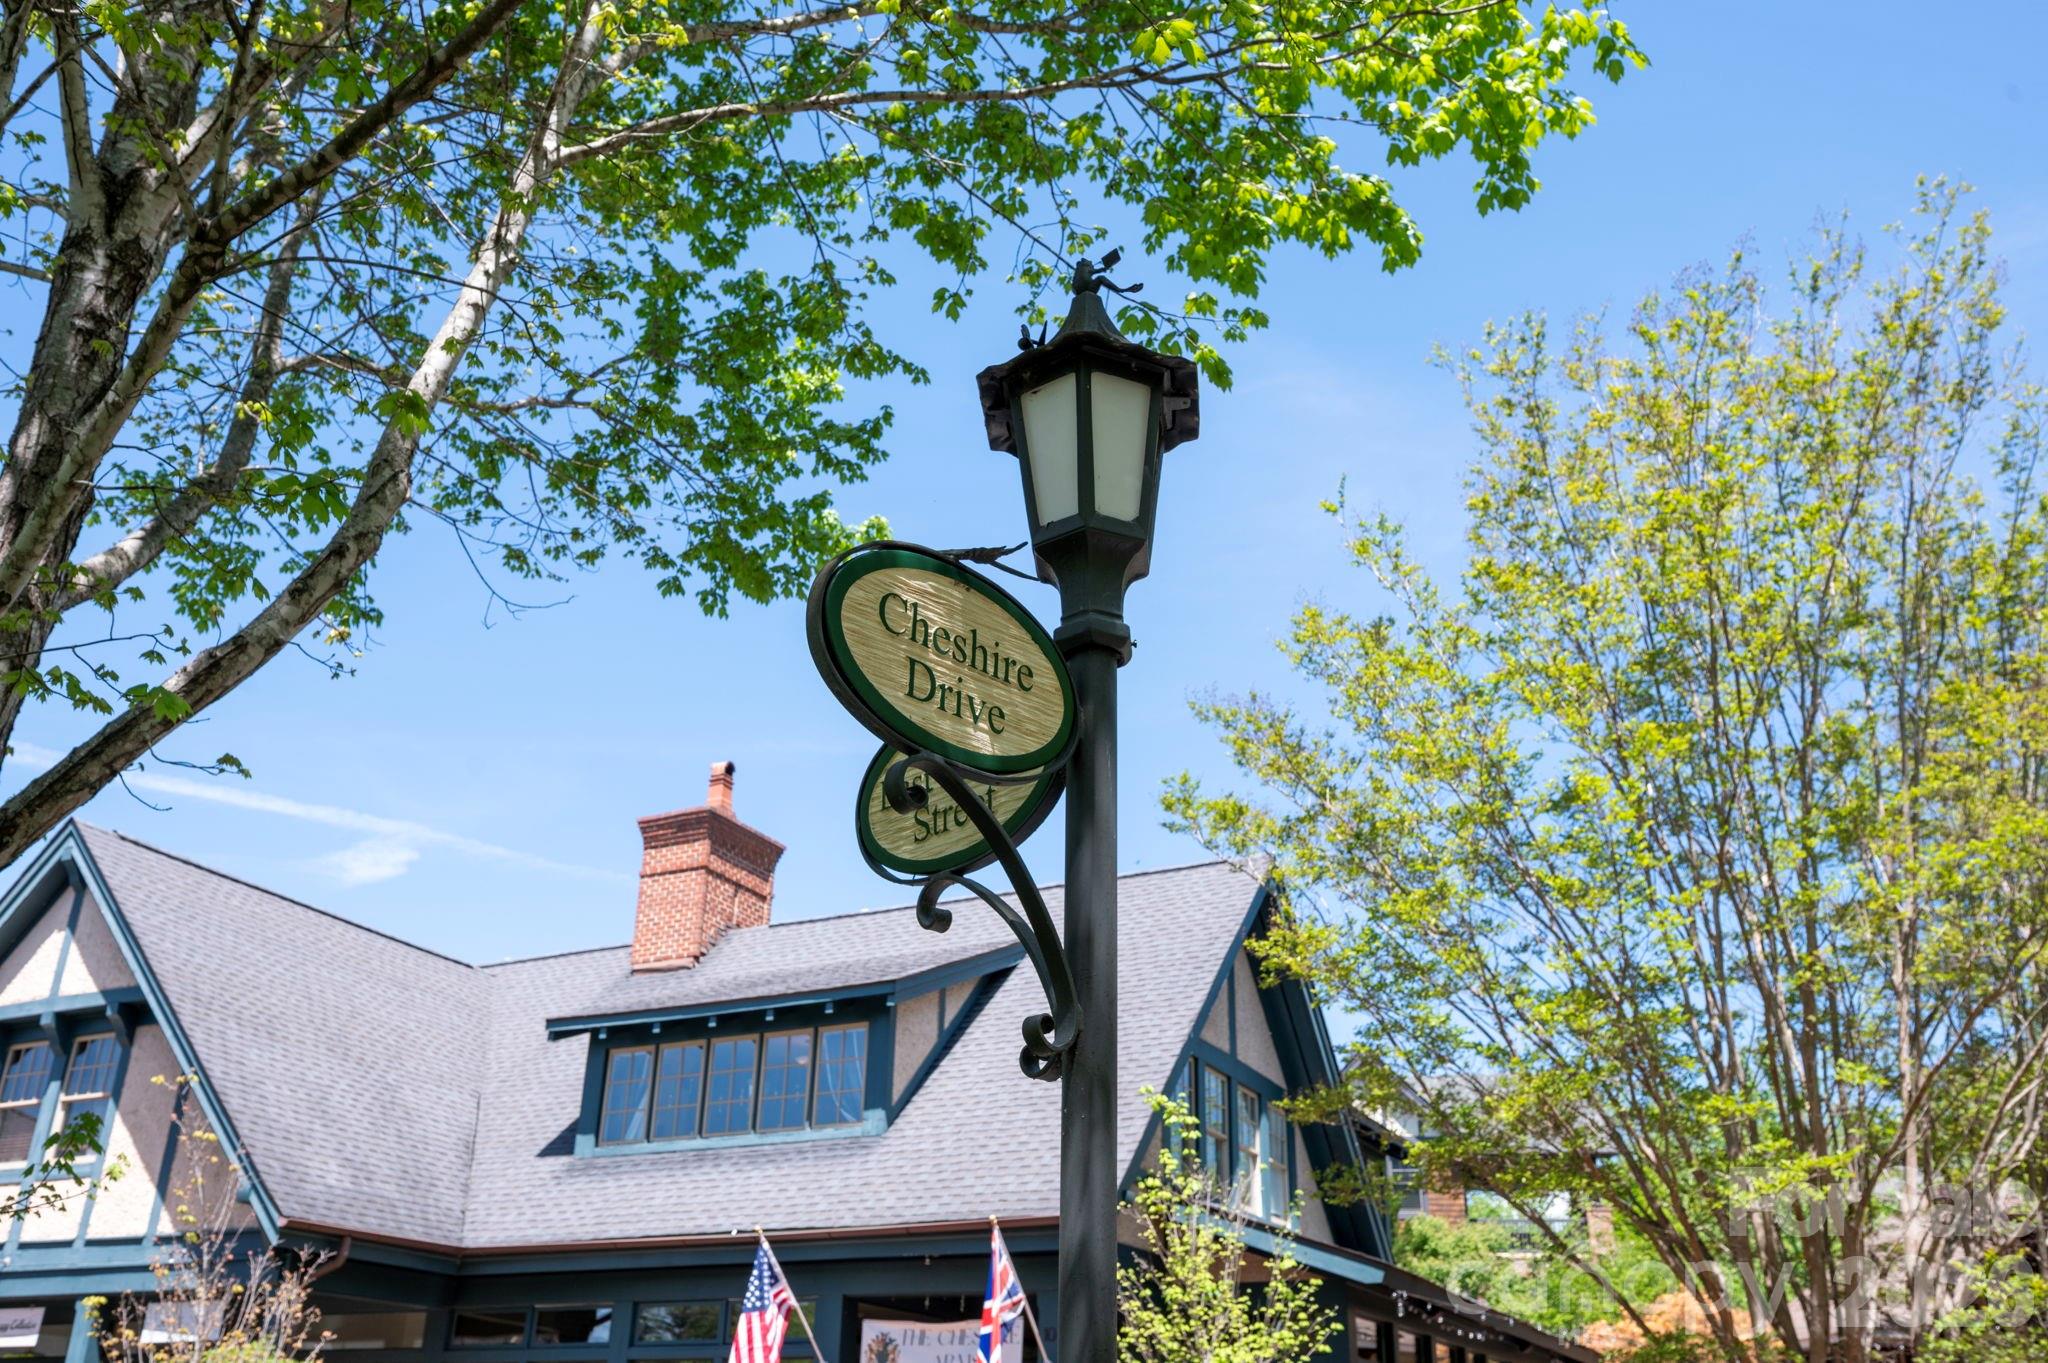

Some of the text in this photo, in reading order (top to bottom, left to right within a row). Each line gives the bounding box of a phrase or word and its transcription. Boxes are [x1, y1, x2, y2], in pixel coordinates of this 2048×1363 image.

[878, 591, 1035, 693] Cheshire
[905, 655, 1007, 735] Drive
[913, 784, 997, 843] Stret
